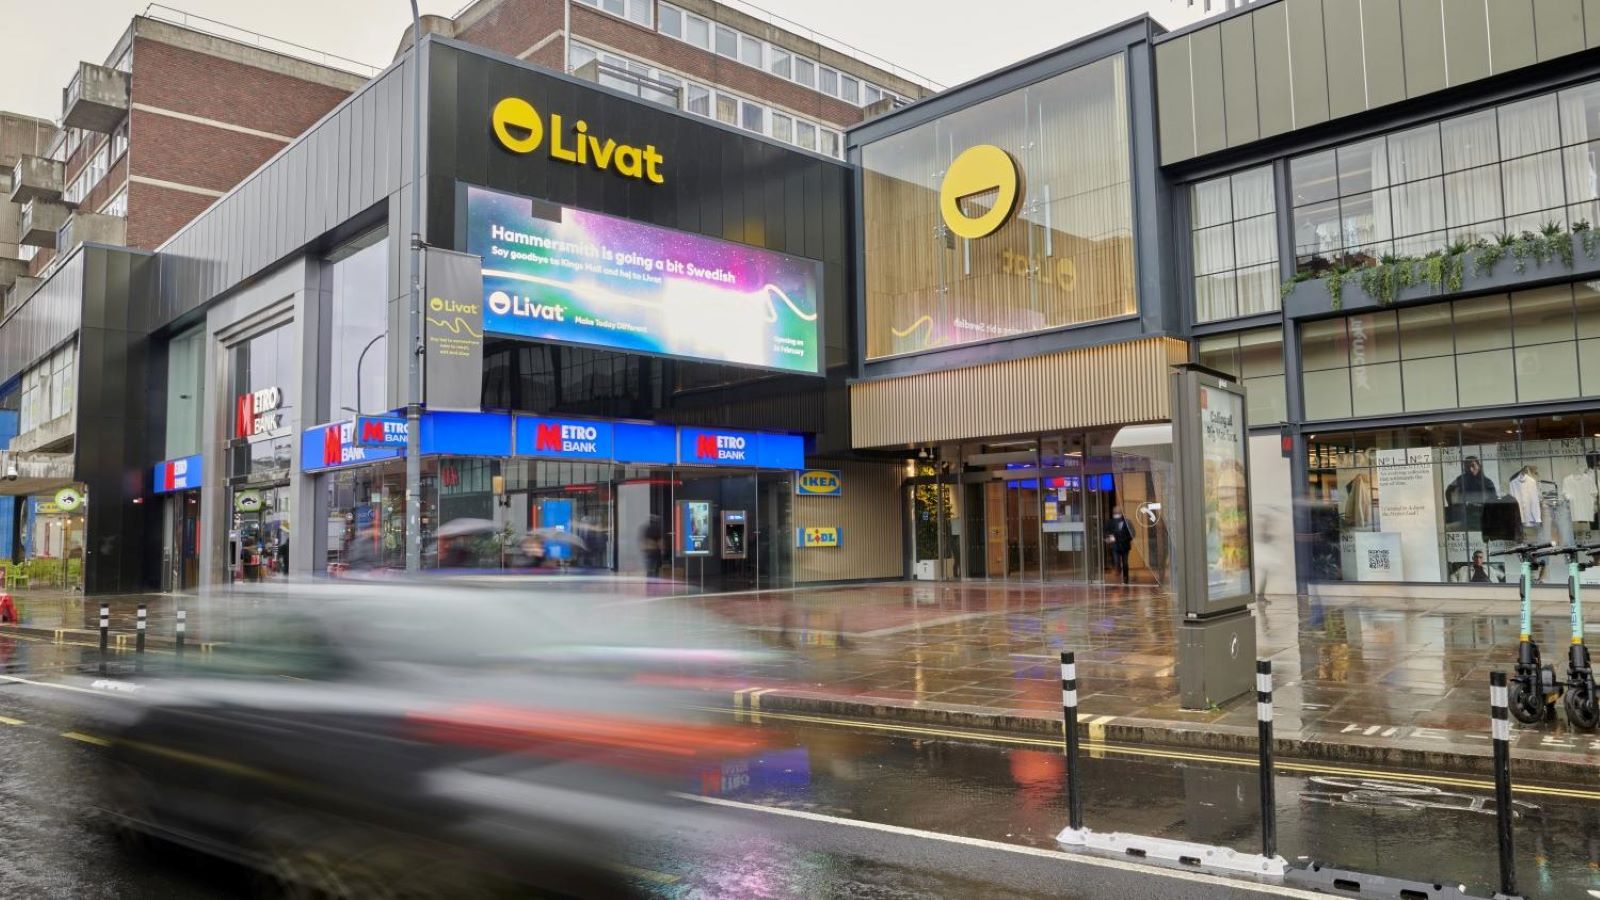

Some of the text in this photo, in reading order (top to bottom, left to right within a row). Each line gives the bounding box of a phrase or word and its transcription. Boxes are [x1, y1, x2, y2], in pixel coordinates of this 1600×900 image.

[551, 113, 664, 184] Livat
[491, 224, 736, 284] Hammersmith is going a bit Swedish
[491, 245, 509, 258] Say
[510, 250, 549, 265] goodbye
[603, 267, 619, 277] and
[445, 299, 478, 314] Livat
[513, 295, 564, 322] Livat
[575, 314, 594, 326] Make
[254, 413, 277, 434] BANK
[536, 423, 597, 450] METRO
[563, 441, 597, 453] BANK
[697, 434, 745, 459] METRO
[342, 447, 365, 462] BANK
[718, 450, 746, 460] BANK
[803, 476, 837, 487] IKEA
